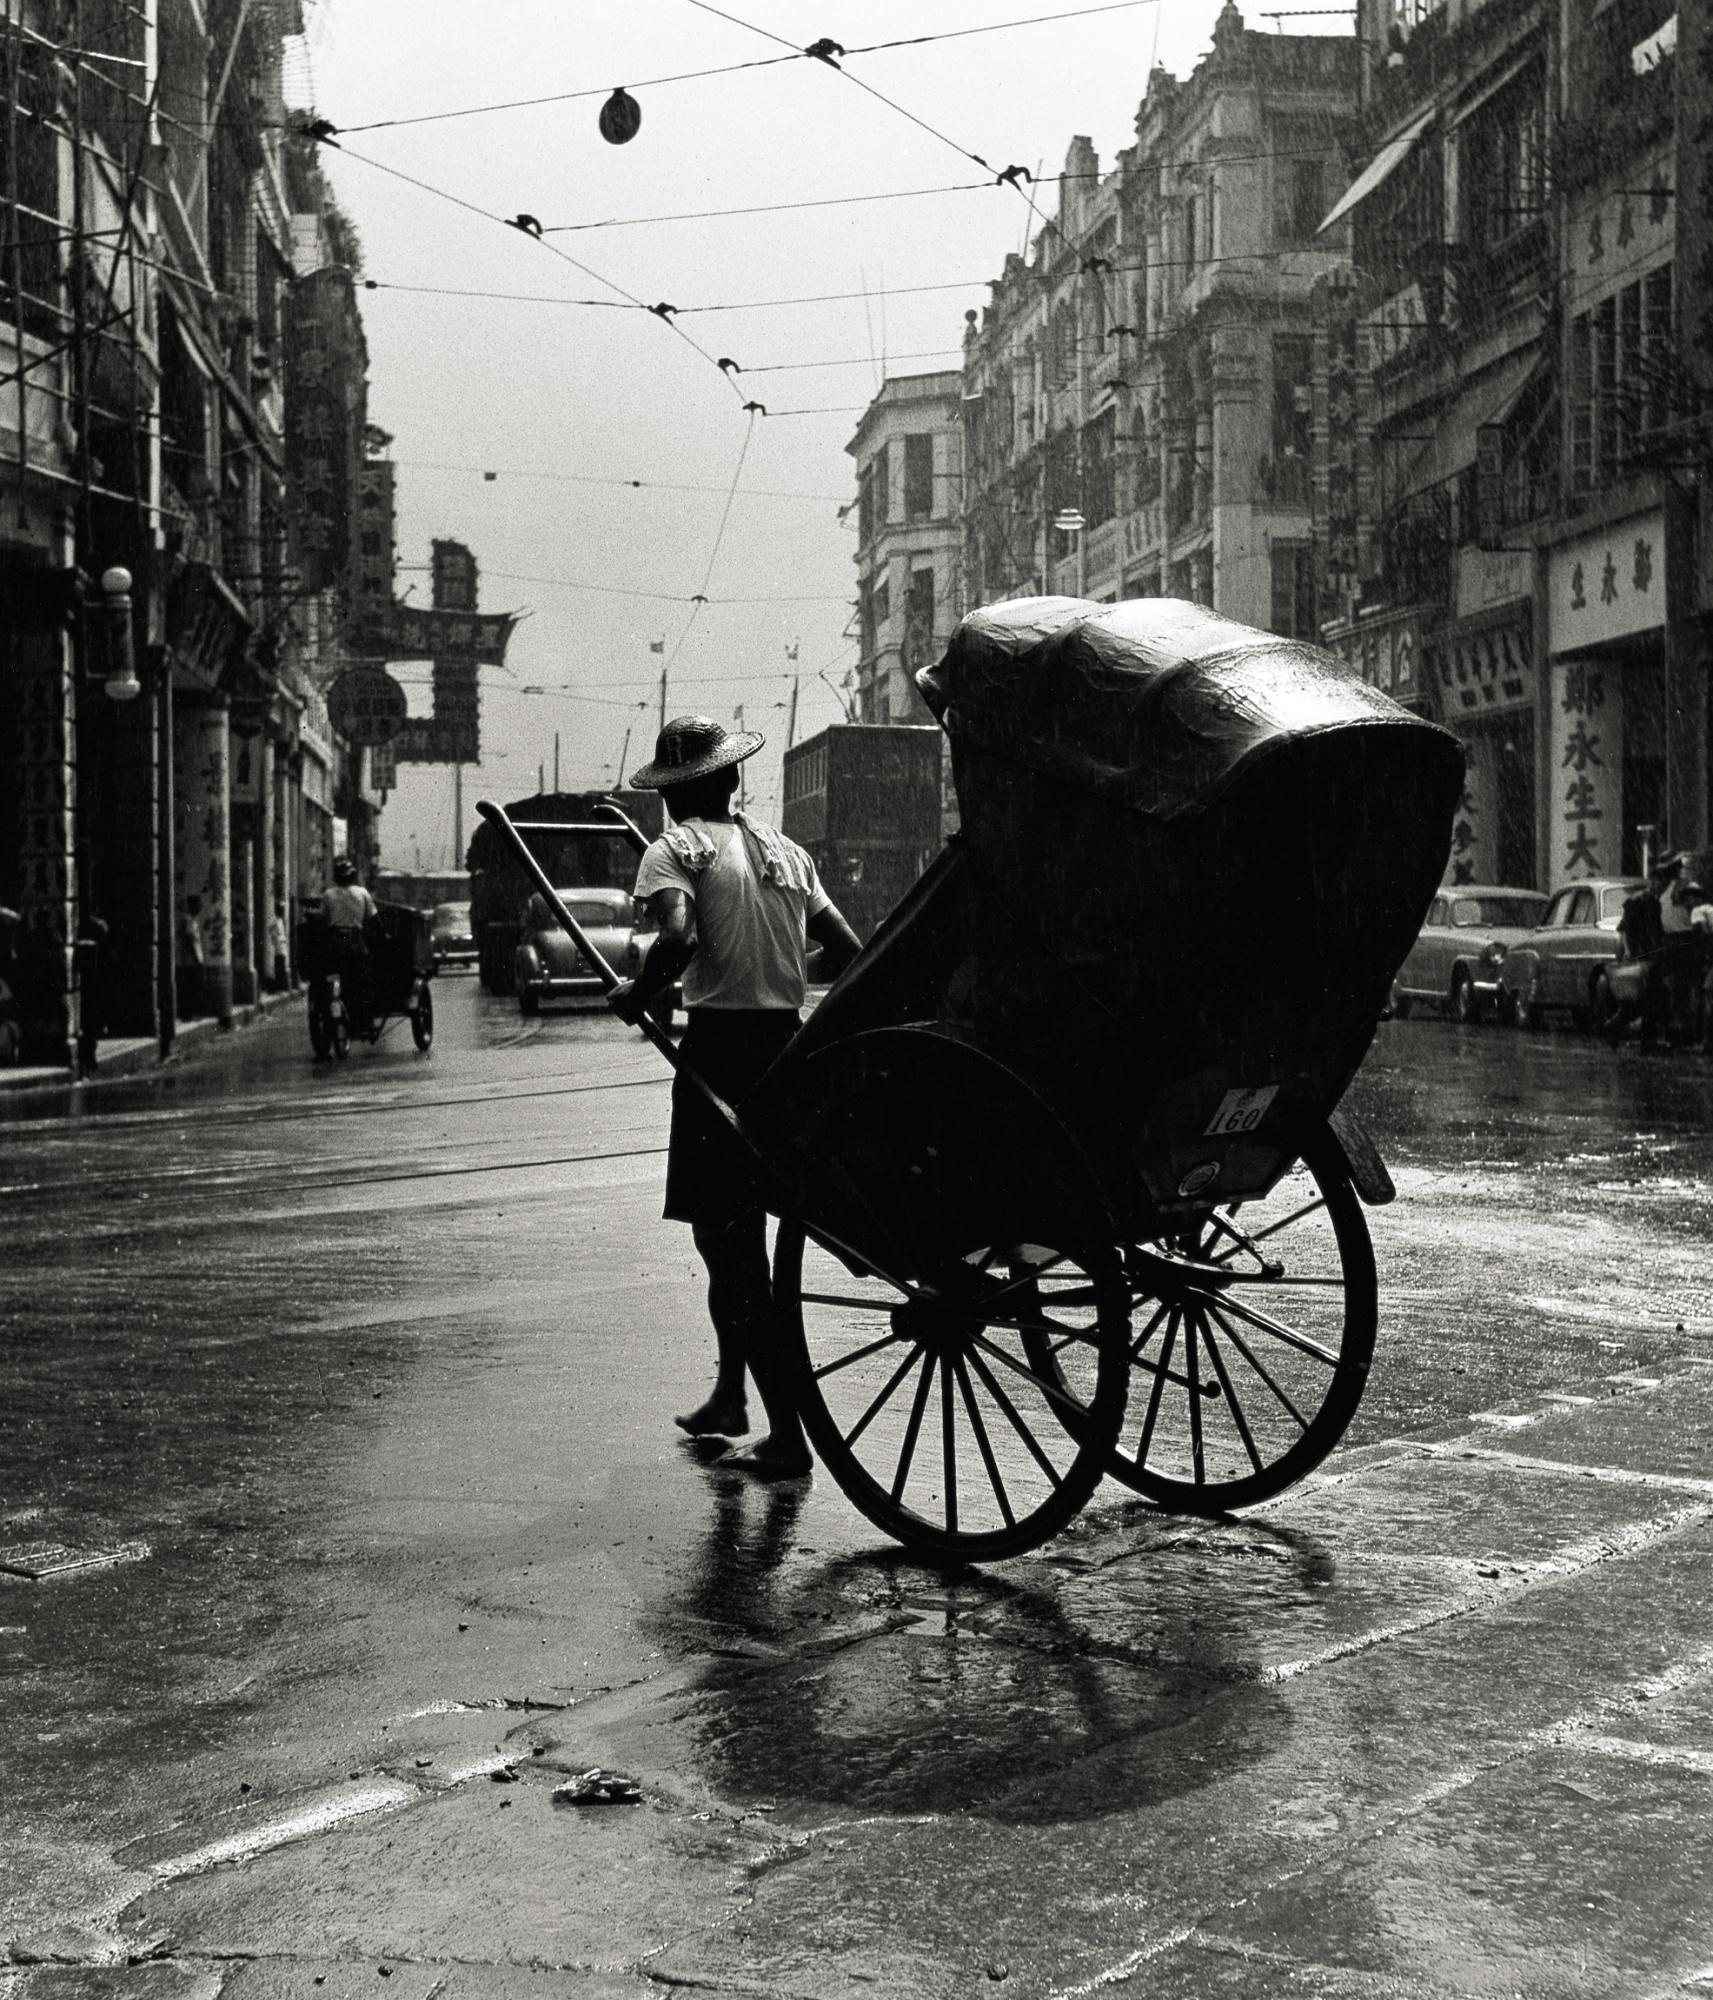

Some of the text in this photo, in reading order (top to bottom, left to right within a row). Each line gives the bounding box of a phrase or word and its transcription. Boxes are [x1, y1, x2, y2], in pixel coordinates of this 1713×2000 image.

[1560, 664, 1606, 880] 鄭永生大
[1211, 1108, 1260, 1132] 160
